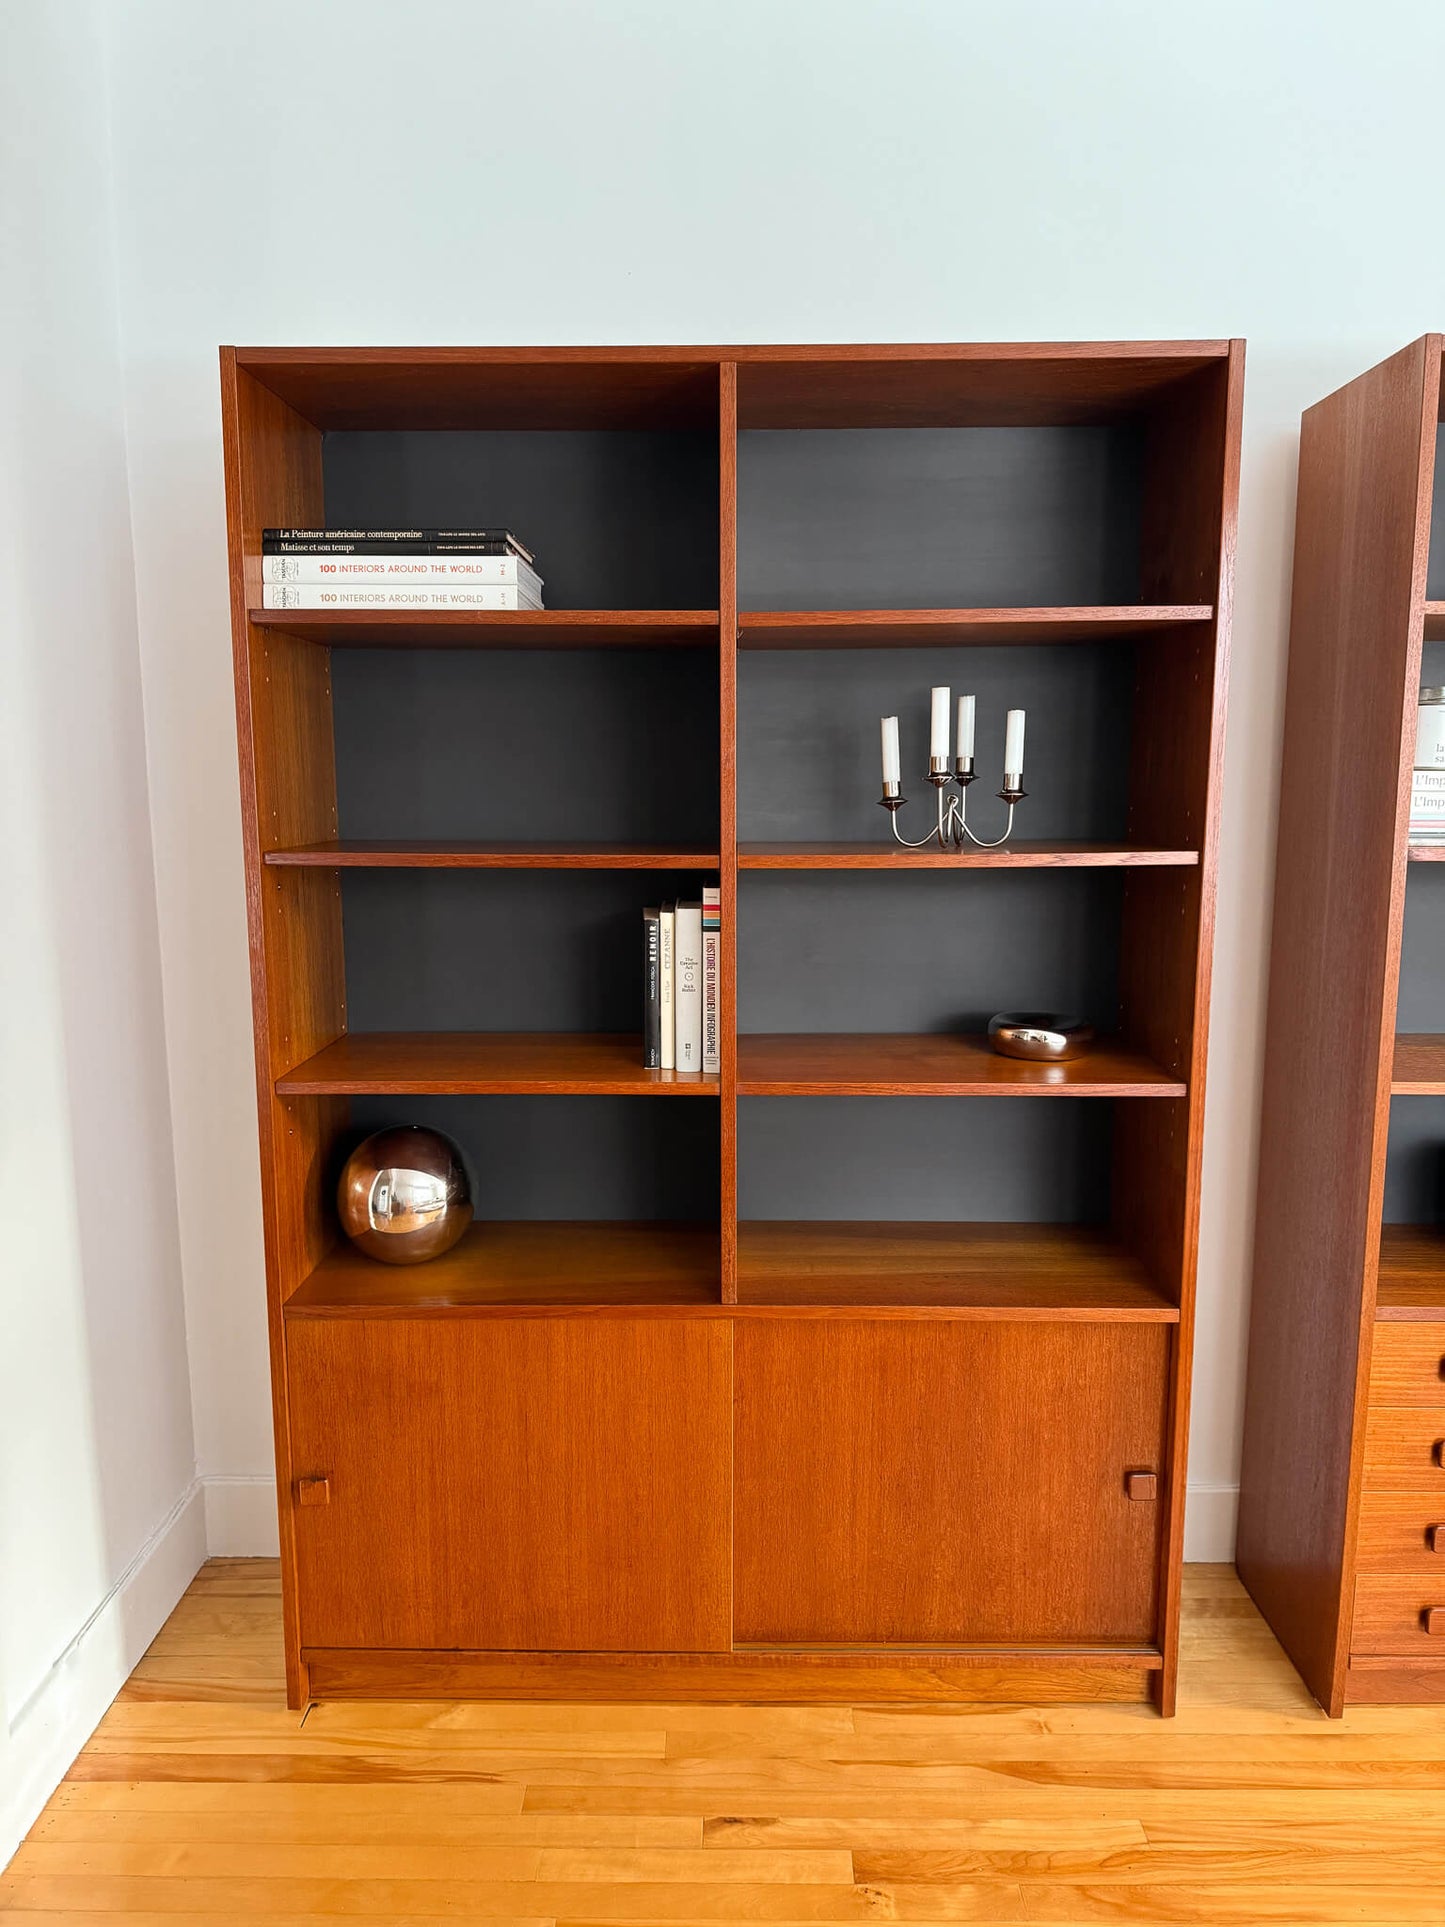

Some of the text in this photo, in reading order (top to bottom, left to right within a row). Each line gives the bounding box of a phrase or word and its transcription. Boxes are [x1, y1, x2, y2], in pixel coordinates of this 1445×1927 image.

[280, 529, 423, 541] La Peinture américaine contemporaine
[280, 542, 308, 551] Matisse
[309, 543, 317, 551] et
[332, 543, 355, 553] temps
[319, 564, 483, 573] 100 INTERIORS AROUND THE WORLD
[320, 593, 484, 603] 100 INTERIORS AROUND THE WORLD
[649, 925, 657, 962] RENOIR
[706, 938, 716, 971] L'HISTOIRE
[706, 972, 716, 982] DU
[706, 1013, 716, 1055] INFOGRAPHIE
